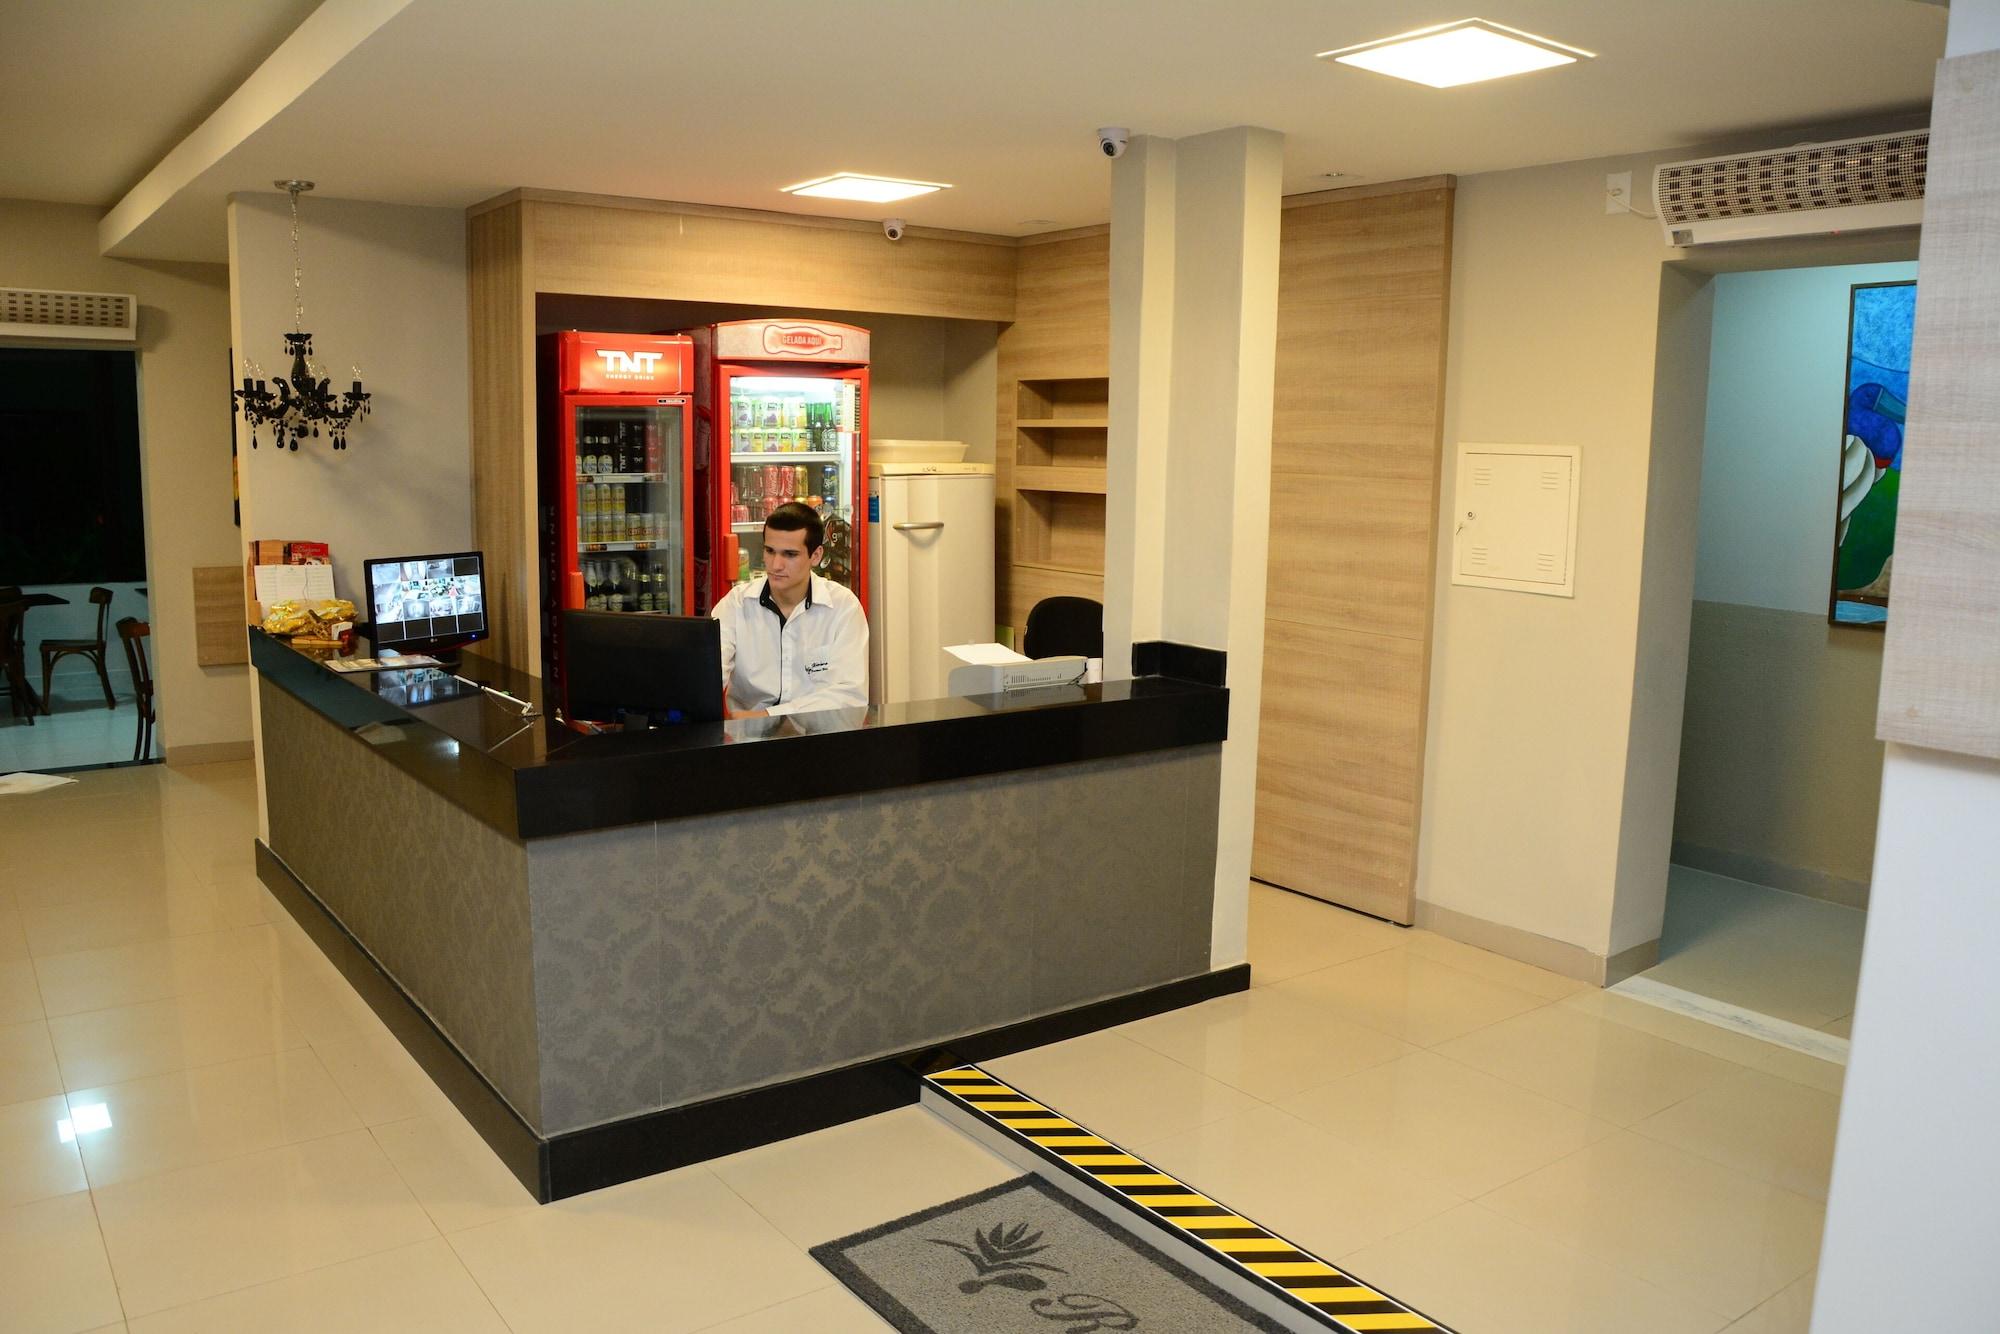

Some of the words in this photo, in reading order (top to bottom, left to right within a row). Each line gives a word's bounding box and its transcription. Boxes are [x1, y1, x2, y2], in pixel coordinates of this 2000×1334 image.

[782, 335, 806, 345] GELADA
[807, 336, 822, 346] AQUI
[596, 350, 664, 373] TNT
